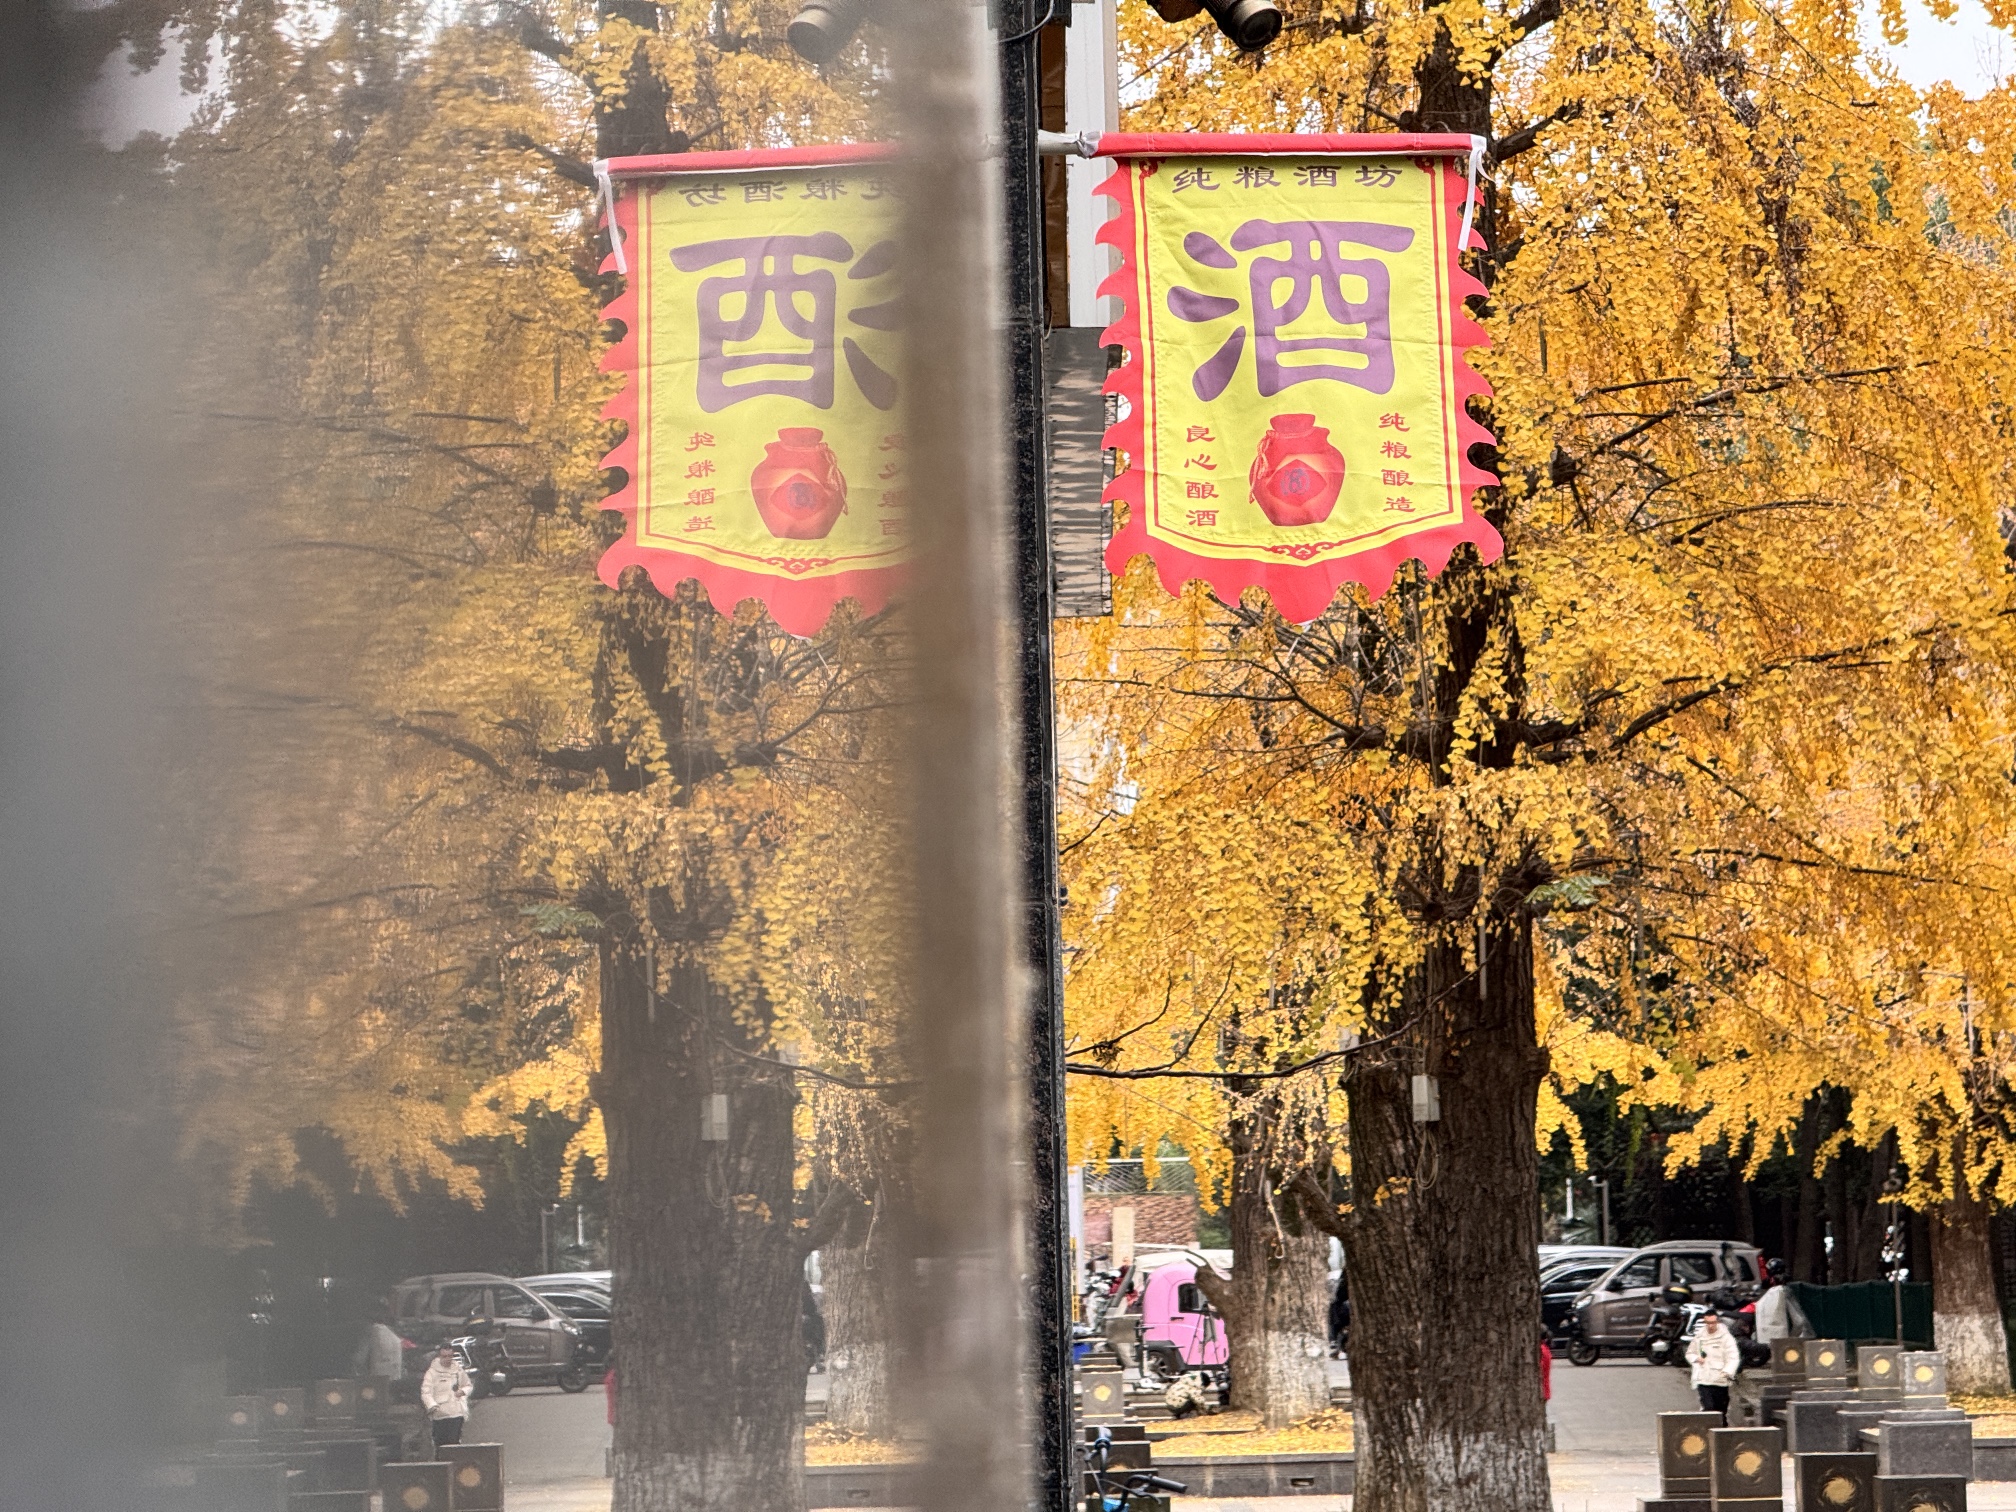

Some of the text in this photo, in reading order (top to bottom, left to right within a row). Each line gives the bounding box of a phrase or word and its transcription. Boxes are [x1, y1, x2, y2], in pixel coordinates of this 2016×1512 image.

[1172, 164, 1403, 194] 纯粮酒坊
[1166, 218, 1416, 402] 酒
[1184, 424, 1220, 528] 良心酿酒
[1377, 412, 1416, 514] 纯粮酿造
